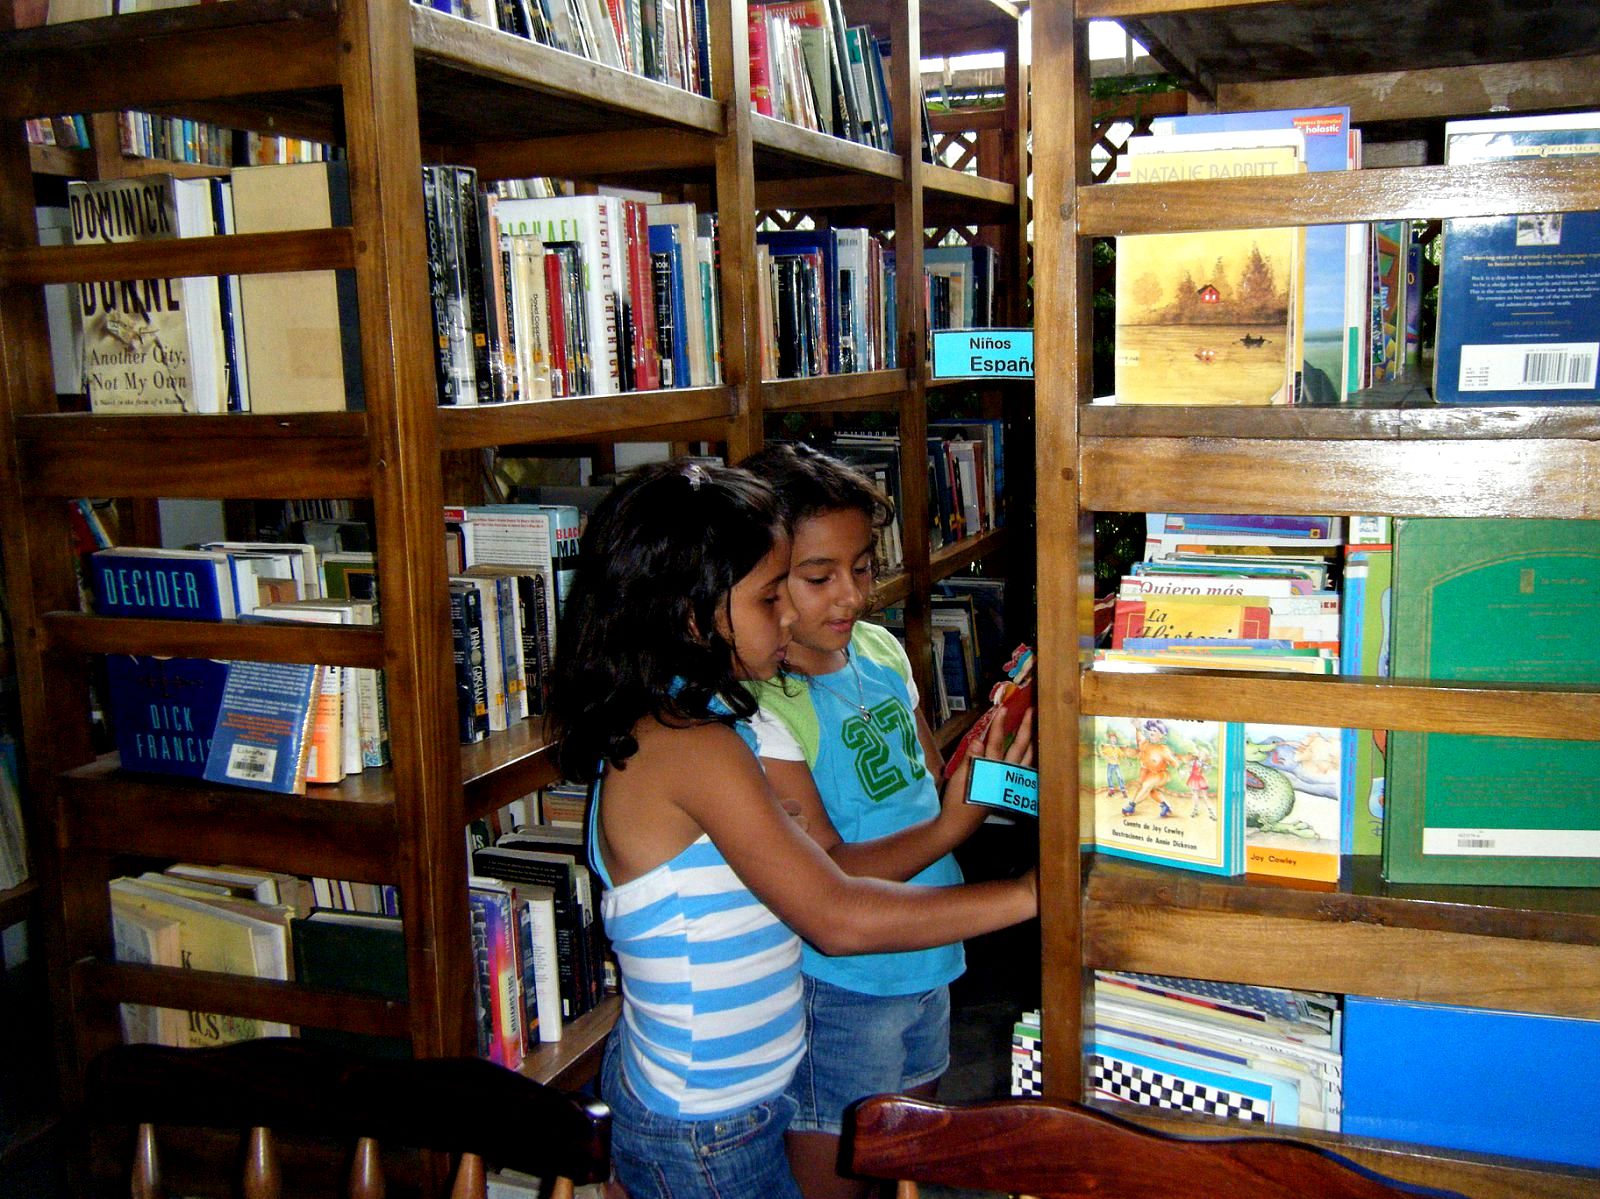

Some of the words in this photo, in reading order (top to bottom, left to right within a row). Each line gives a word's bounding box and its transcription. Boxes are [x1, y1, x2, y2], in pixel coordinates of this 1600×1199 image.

[1297, 124, 1340, 133] holastic
[1136, 164, 1203, 183] NATALIE
[1208, 161, 1279, 180] BABBITT
[70, 184, 170, 241] DOMINICK
[598, 204, 612, 280] MICHAEL
[434, 300, 449, 374] SEIZRE
[604, 293, 619, 379] CRICHTON
[969, 337, 1012, 349] Niños
[90, 347, 147, 366] Another
[153, 345, 187, 369] City,
[92, 373, 119, 391] Not
[124, 372, 147, 396] My
[153, 370, 187, 389] Own
[555, 527, 581, 540] BLAC
[103, 568, 200, 609] DECIDER
[1139, 580, 1201, 595] Quiero
[1206, 583, 1244, 596] más
[1146, 608, 1168, 623] La
[469, 626, 481, 649] JOHN
[149, 704, 194, 732] DICK
[841, 695, 927, 803] 27
[1005, 770, 1037, 789] Niños
[1250, 852, 1265, 863] Joy
